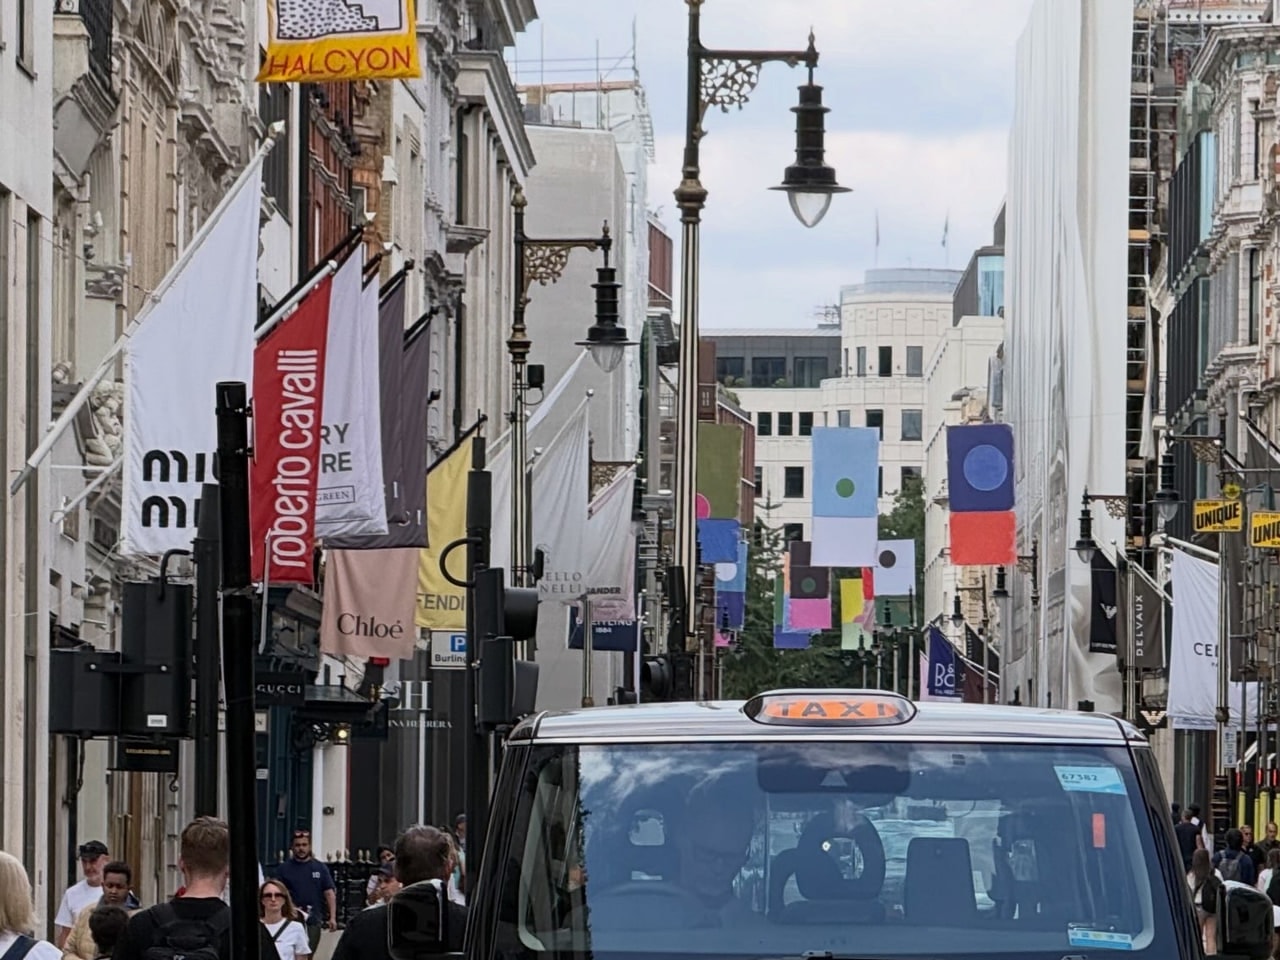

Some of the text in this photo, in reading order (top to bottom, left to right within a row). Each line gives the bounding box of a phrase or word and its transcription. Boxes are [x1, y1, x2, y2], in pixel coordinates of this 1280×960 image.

[268, 46, 411, 76] HALCYON
[142, 449, 220, 483] mi
[271, 349, 318, 568] roberto cavalli
[1196, 502, 1240, 529] UNIQUE
[337, 612, 404, 640] Chloé
[1136, 595, 1144, 656] DELVAUX
[257, 684, 301, 694] GUCCI
[776, 702, 886, 717] TAXI
